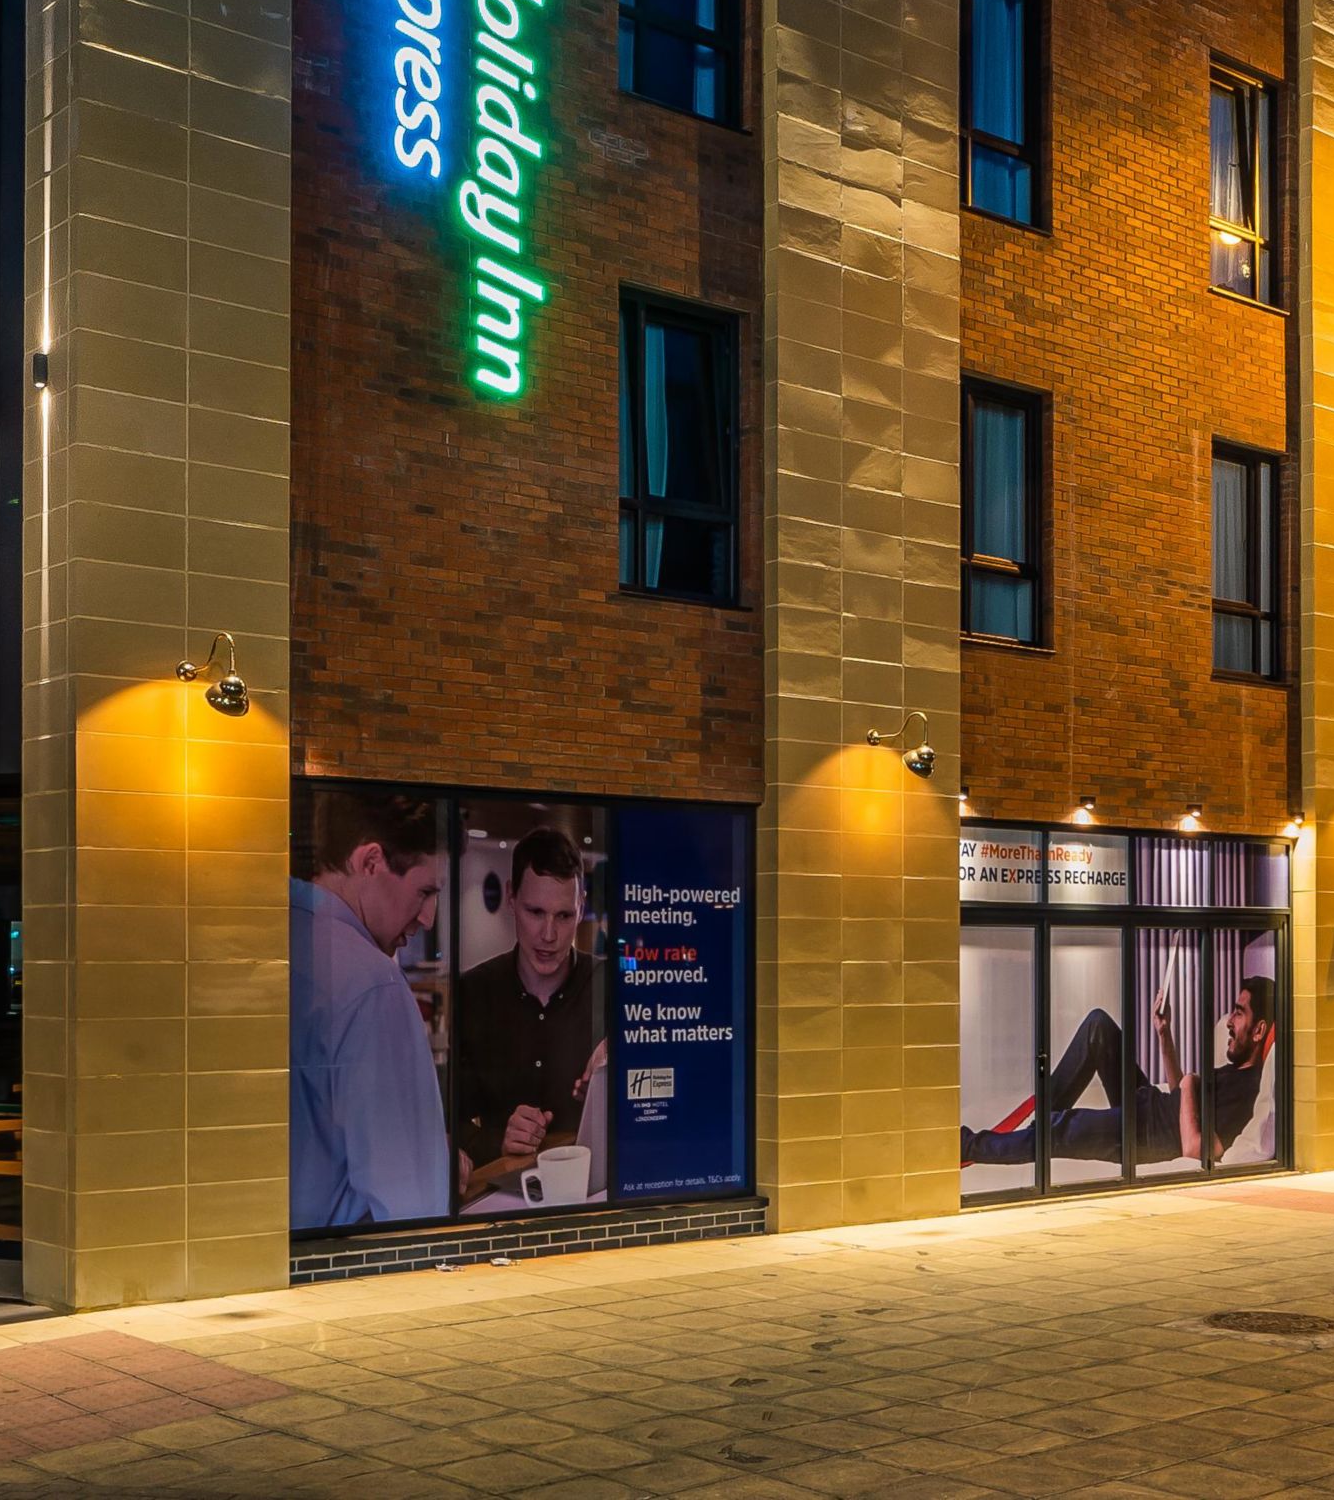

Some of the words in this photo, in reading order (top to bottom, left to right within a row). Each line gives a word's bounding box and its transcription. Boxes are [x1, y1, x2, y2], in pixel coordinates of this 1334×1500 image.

[476, 256, 545, 397] Inn
[960, 843, 976, 856] AY
[959, 867, 976, 882] OR
[979, 867, 998, 883] AN
[1001, 869, 1061, 885] EXPRESS
[1064, 870, 1126, 886] RECHARGE
[624, 884, 741, 904] High-powered
[624, 908, 697, 927] meeting.
[624, 945, 660, 961] Low
[664, 946, 698, 961] rate
[624, 966, 708, 986] approved.
[624, 1004, 652, 1021] We
[657, 1004, 701, 1020] know
[624, 1027, 667, 1043] what
[672, 1025, 733, 1041] matters
[623, 1183, 635, 1191] Ask
[645, 1180, 674, 1190] reception
[675, 1178, 684, 1187] for
